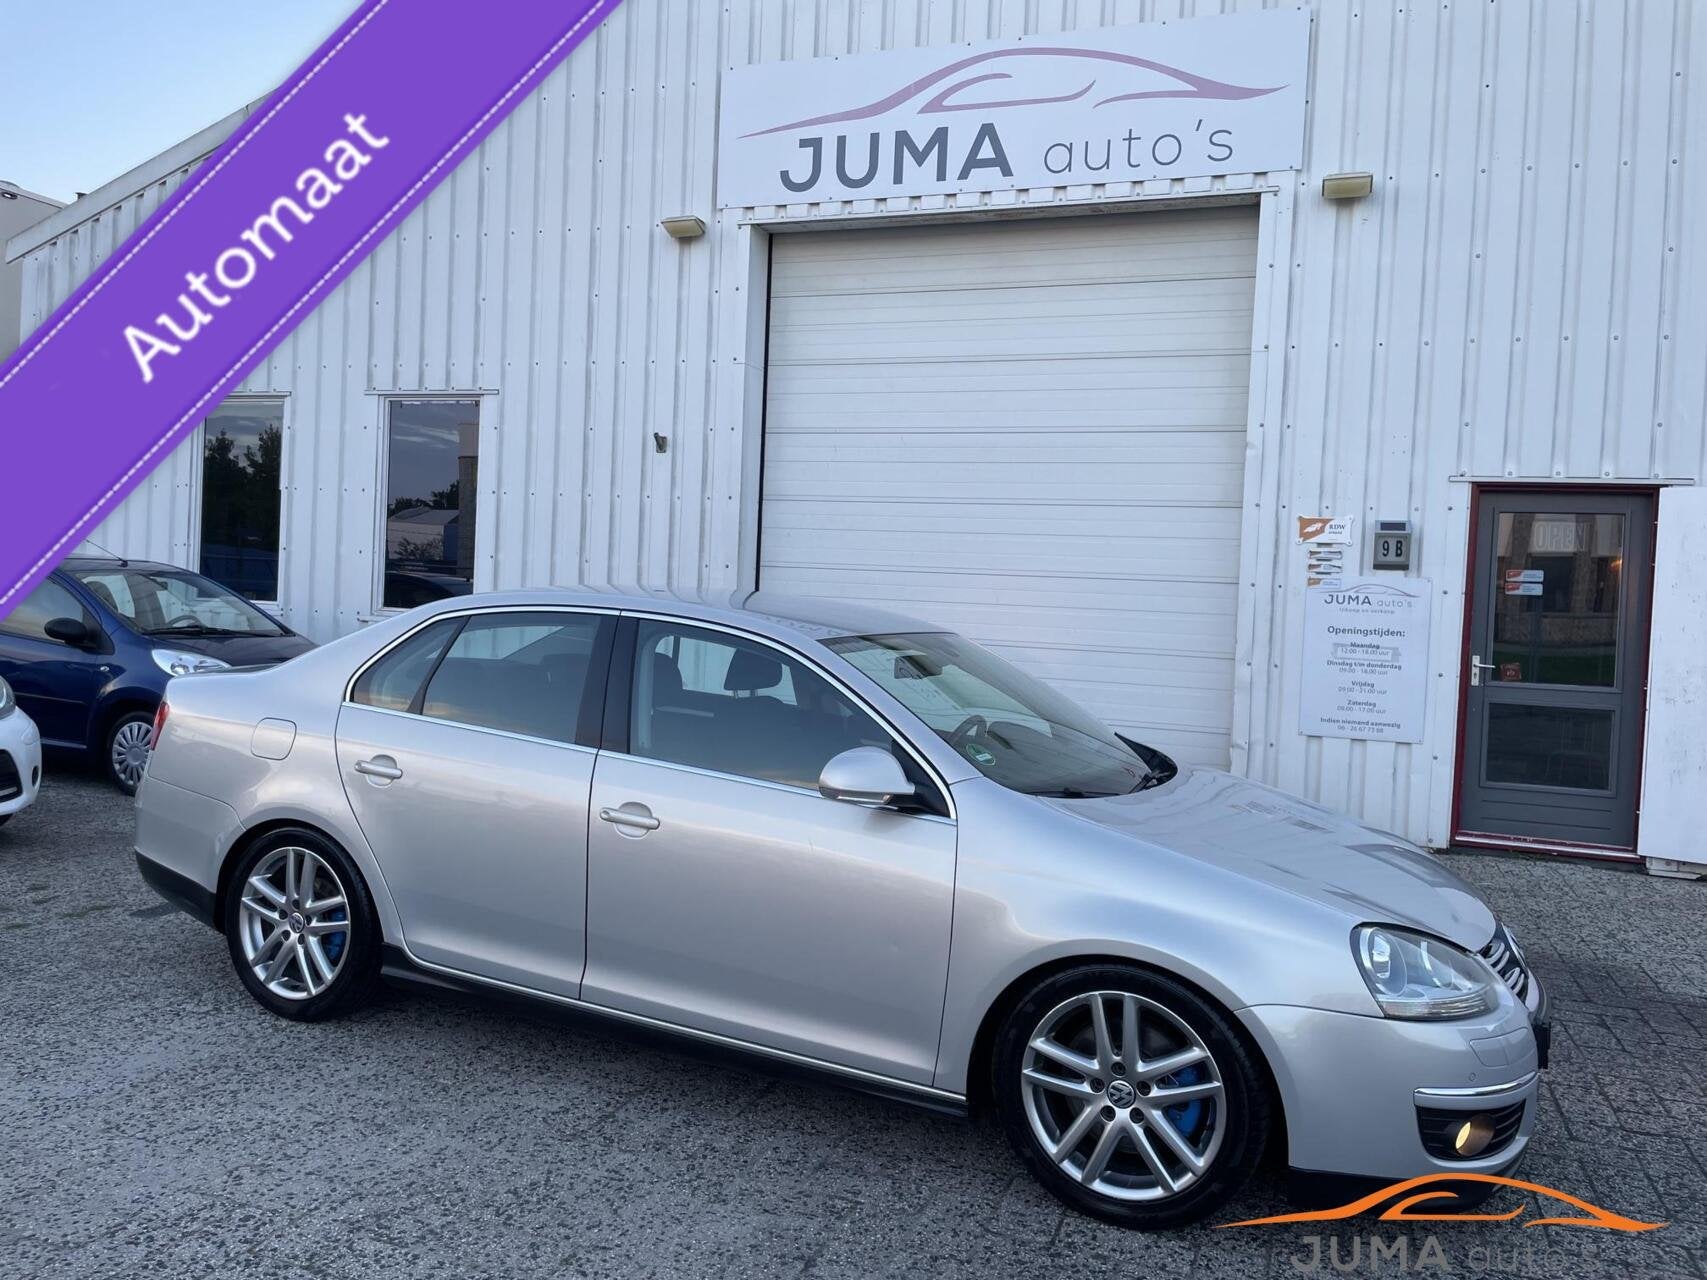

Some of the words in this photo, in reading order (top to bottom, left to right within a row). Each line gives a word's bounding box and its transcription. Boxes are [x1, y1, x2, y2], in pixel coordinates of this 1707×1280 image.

[779, 122, 1014, 194] JUMA
[1043, 118, 1235, 175] auto's
[1382, 540, 1390, 557] 9
[1395, 540, 1403, 557] B
[1324, 594, 1372, 606] JUMA
[1376, 599, 1412, 608] auto's
[1327, 625, 1406, 638] Openingstijden:
[1366, 662, 1402, 670] donderdag
[1347, 699, 1377, 708] Zaterdag
